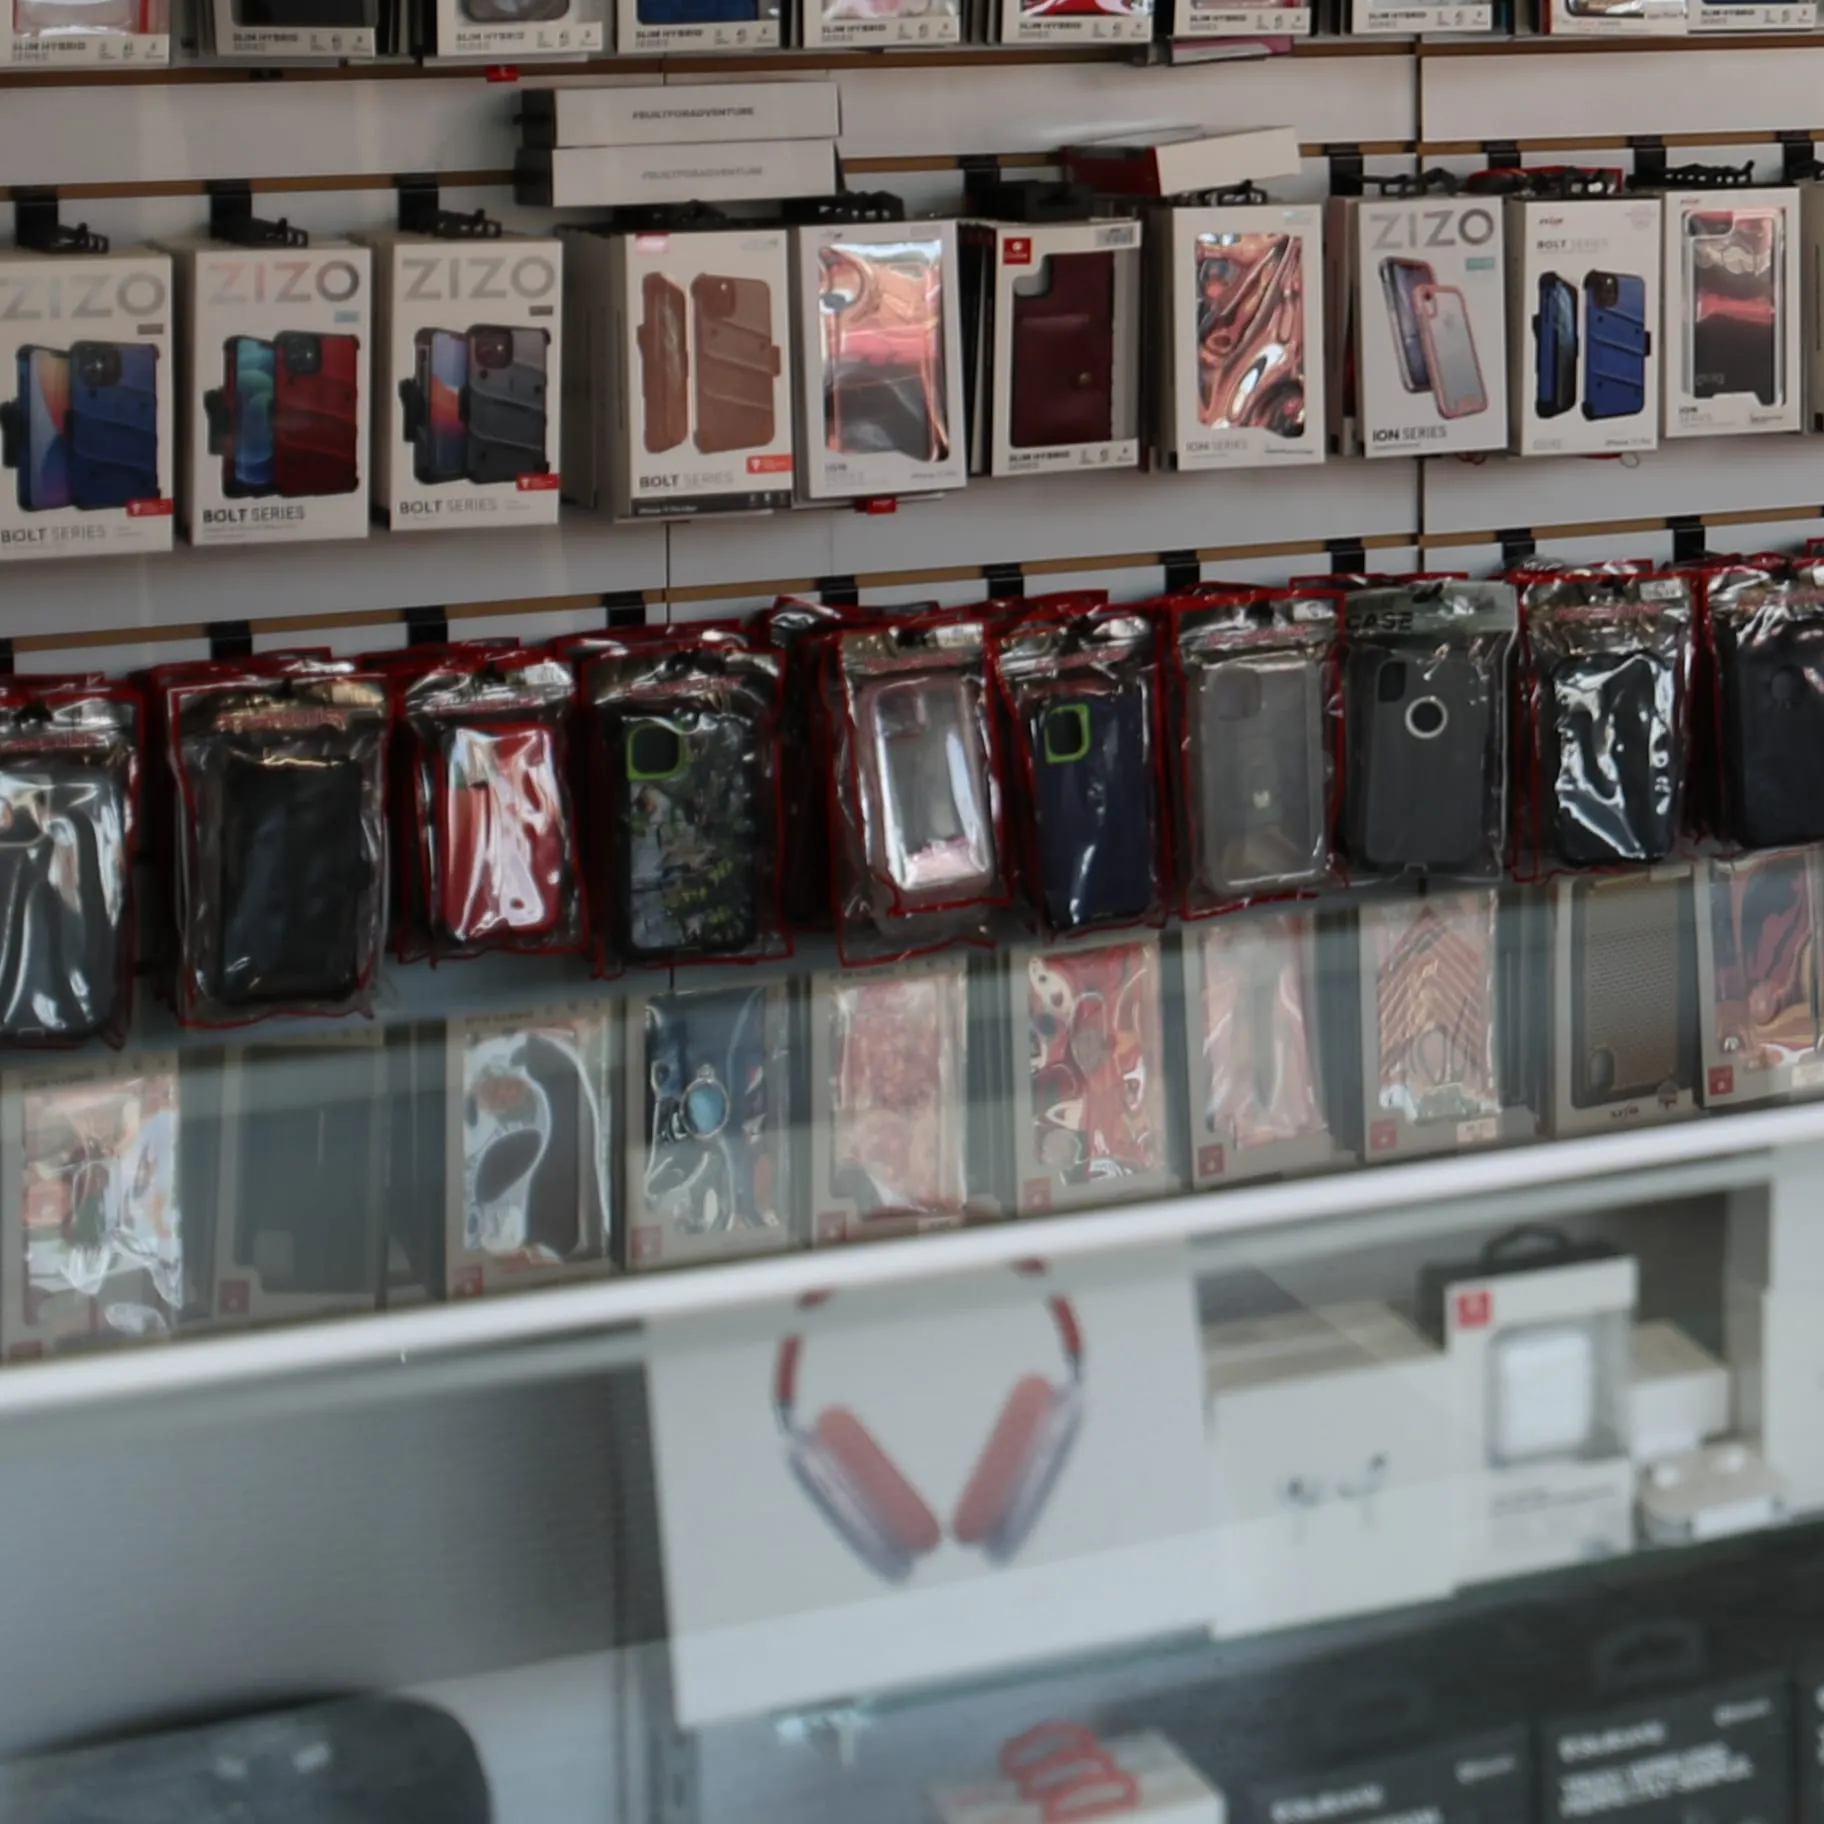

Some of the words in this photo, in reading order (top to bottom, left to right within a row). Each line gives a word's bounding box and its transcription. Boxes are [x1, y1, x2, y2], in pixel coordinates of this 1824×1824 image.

[1371, 207, 1494, 252] ZIZO
[1536, 238, 1566, 249] BOLT
[208, 259, 360, 306] ZIZO
[400, 256, 556, 303] ZIZO
[3, 272, 165, 321] ZIZO
[1373, 429, 1399, 442] ION
[1402, 426, 1447, 440] SERIES
[640, 474, 679, 489] BOLT
[203, 506, 246, 524] BOLT
[250, 504, 305, 521] SERIES
[400, 500, 443, 516] BOLT
[1, 527, 46, 544] BOLT
